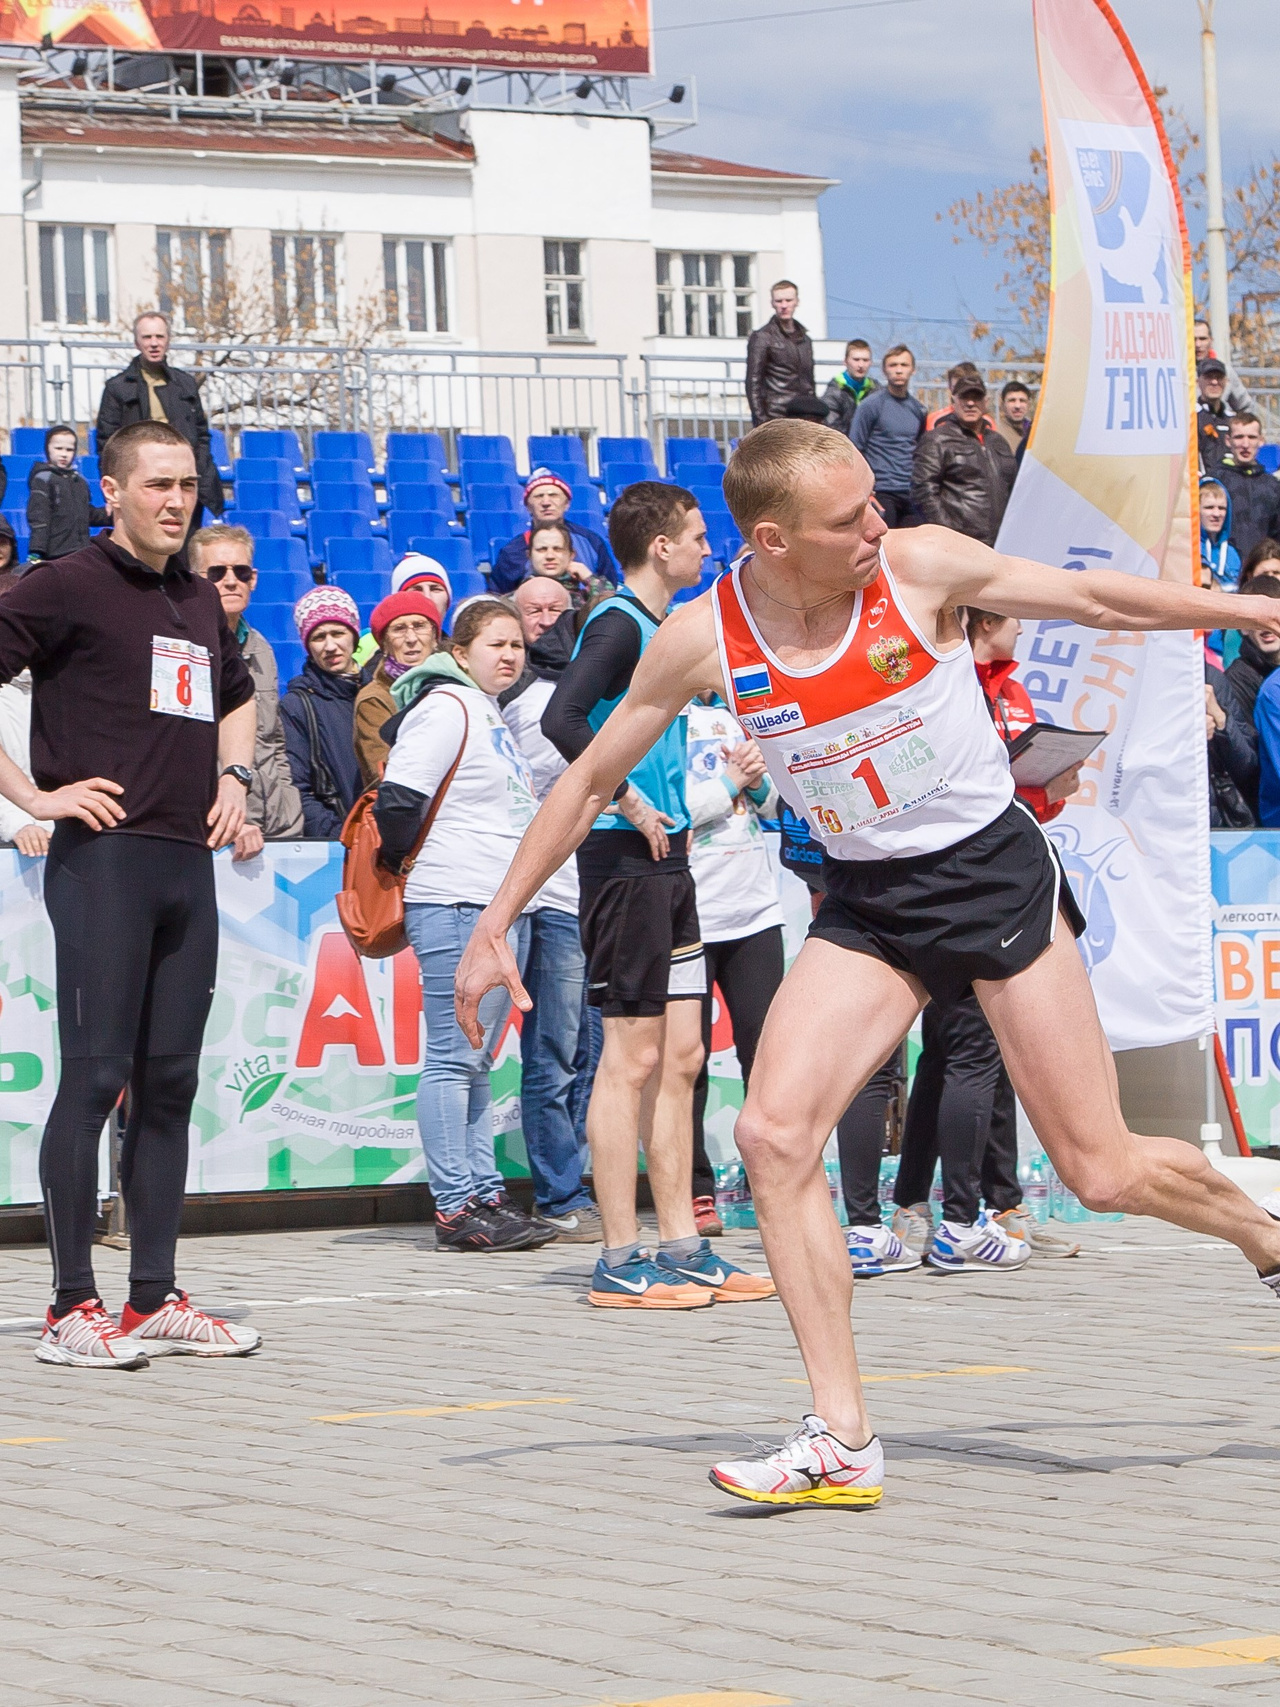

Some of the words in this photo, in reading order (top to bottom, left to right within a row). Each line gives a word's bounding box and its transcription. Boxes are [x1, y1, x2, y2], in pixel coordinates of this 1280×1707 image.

[176, 664, 192, 706] 8
[752, 709, 799, 730] Швабе
[851, 757, 891, 810] 1
[810, 805, 843, 834] 70
[785, 846, 823, 865] adidas
[225, 1054, 271, 1093] vita
[271, 1102, 327, 1129] горная
[329, 1118, 414, 1140] природная
